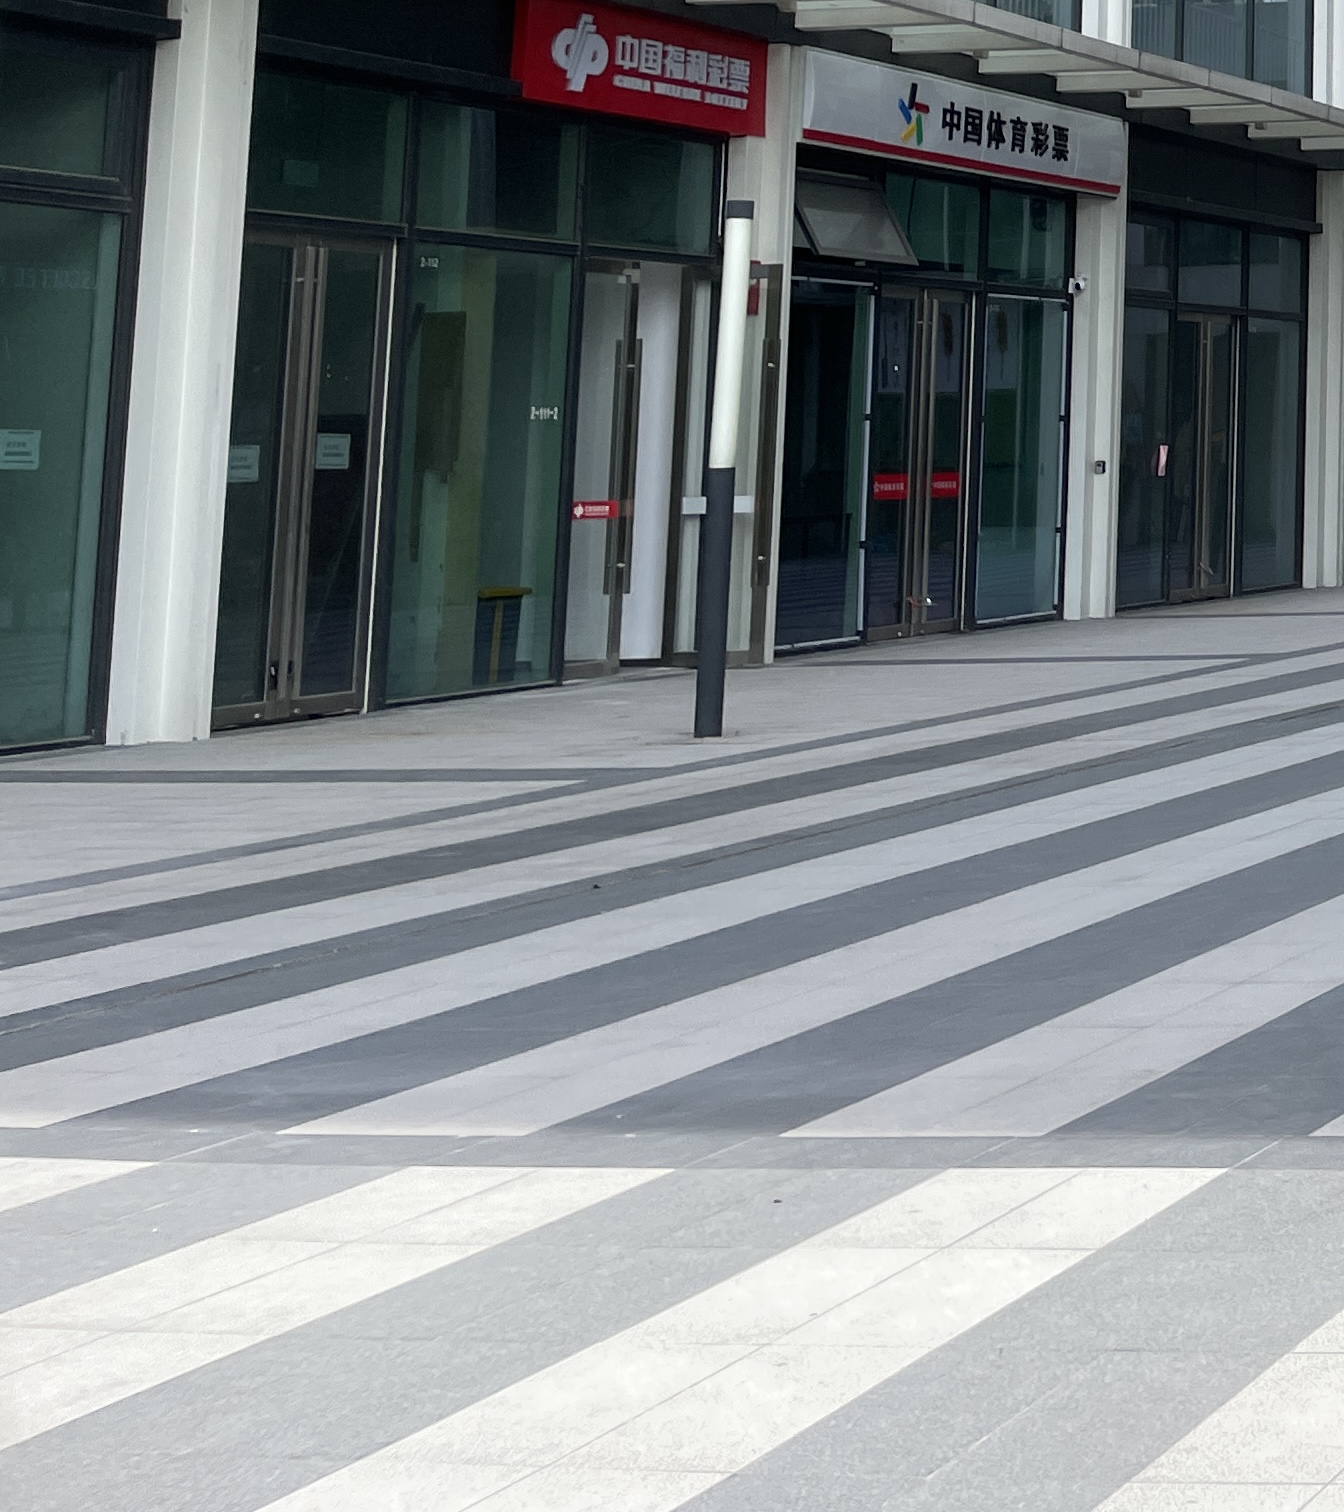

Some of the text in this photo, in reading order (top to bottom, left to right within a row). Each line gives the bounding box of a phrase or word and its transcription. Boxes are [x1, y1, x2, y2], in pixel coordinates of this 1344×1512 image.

[614, 34, 750, 94] 中国福利彩票
[941, 101, 1070, 162] 中国体育彩票
